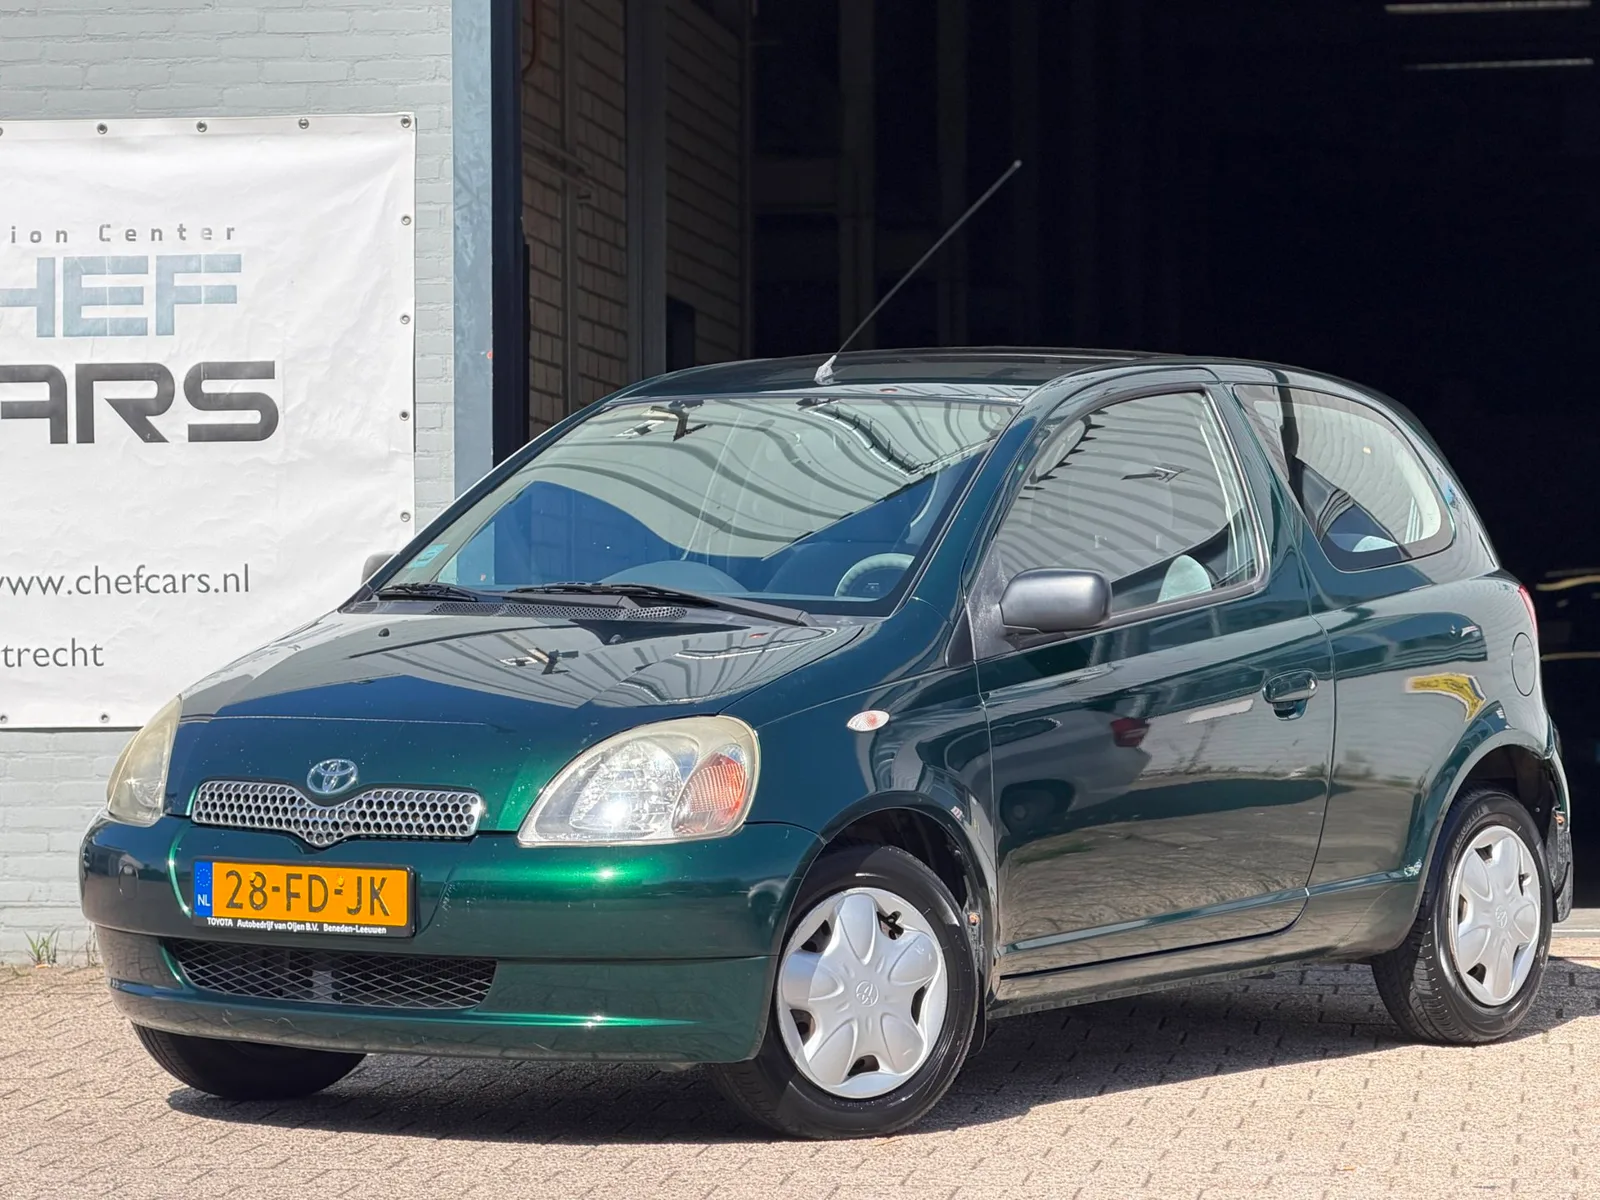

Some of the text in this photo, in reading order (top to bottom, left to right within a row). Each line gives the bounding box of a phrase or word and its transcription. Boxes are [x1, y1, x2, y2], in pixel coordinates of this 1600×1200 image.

[11, 224, 235, 243] ion Center
[1, 638, 104, 668] trecht
[197, 894, 211, 907] NL
[225, 869, 390, 917] 28-FD-JK
[206, 916, 234, 928] TOYOTA
[236, 918, 274, 931] Autobedrijf
[274, 922, 287, 930] van
[305, 922, 320, 932] B.V.
[323, 923, 387, 935] Beneden-Leeuwen
